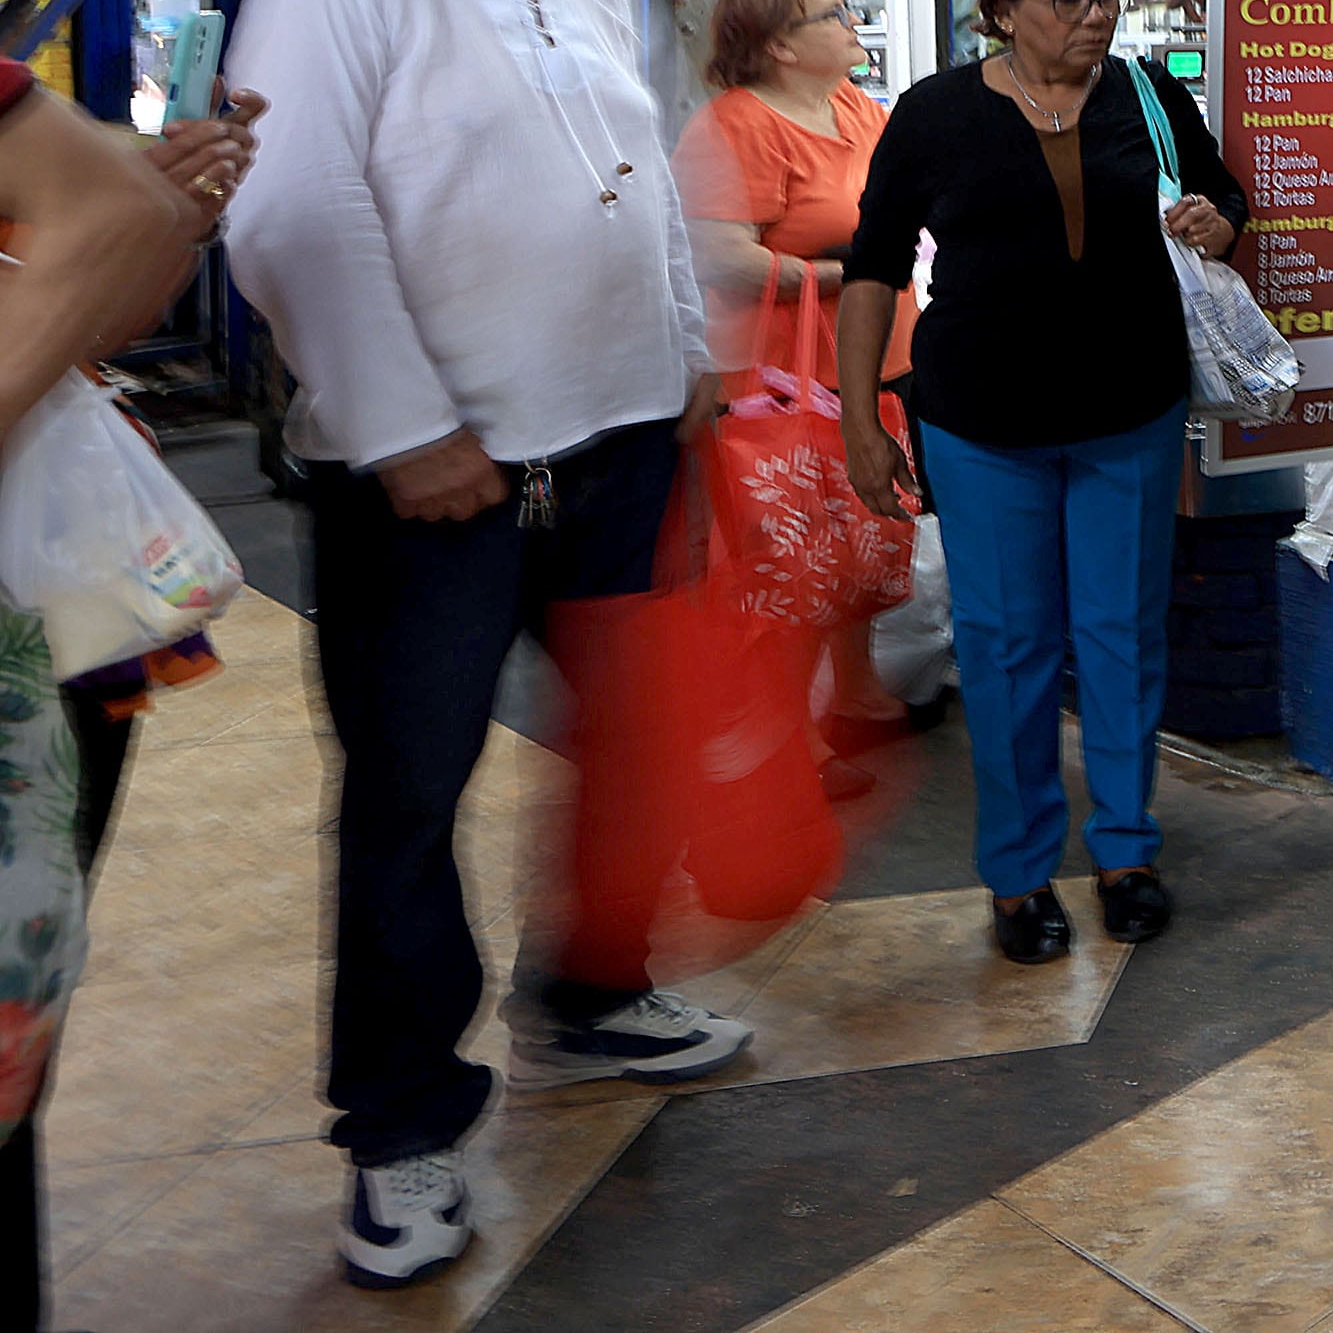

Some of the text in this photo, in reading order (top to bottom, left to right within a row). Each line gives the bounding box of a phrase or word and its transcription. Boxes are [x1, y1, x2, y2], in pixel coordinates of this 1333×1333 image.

[1239, 42, 1284, 59] Hot
[1245, 68, 1262, 84] 12
[1244, 86, 1292, 103] 12 Pan
[1253, 134, 1300, 153] 12 Pan
[1253, 151, 1318, 171] 12 Jamón
[1253, 172, 1270, 190] 12
[1272, 171, 1318, 191] Queso
[1253, 189, 1315, 208] 12 Tortas
[1258, 234, 1297, 250] 8 Pan
[1258, 249, 1315, 268] 8 Jamón
[1258, 270, 1268, 287] 8
[1269, 268, 1314, 287] Queso
[1257, 286, 1313, 306] 8 Tortas
